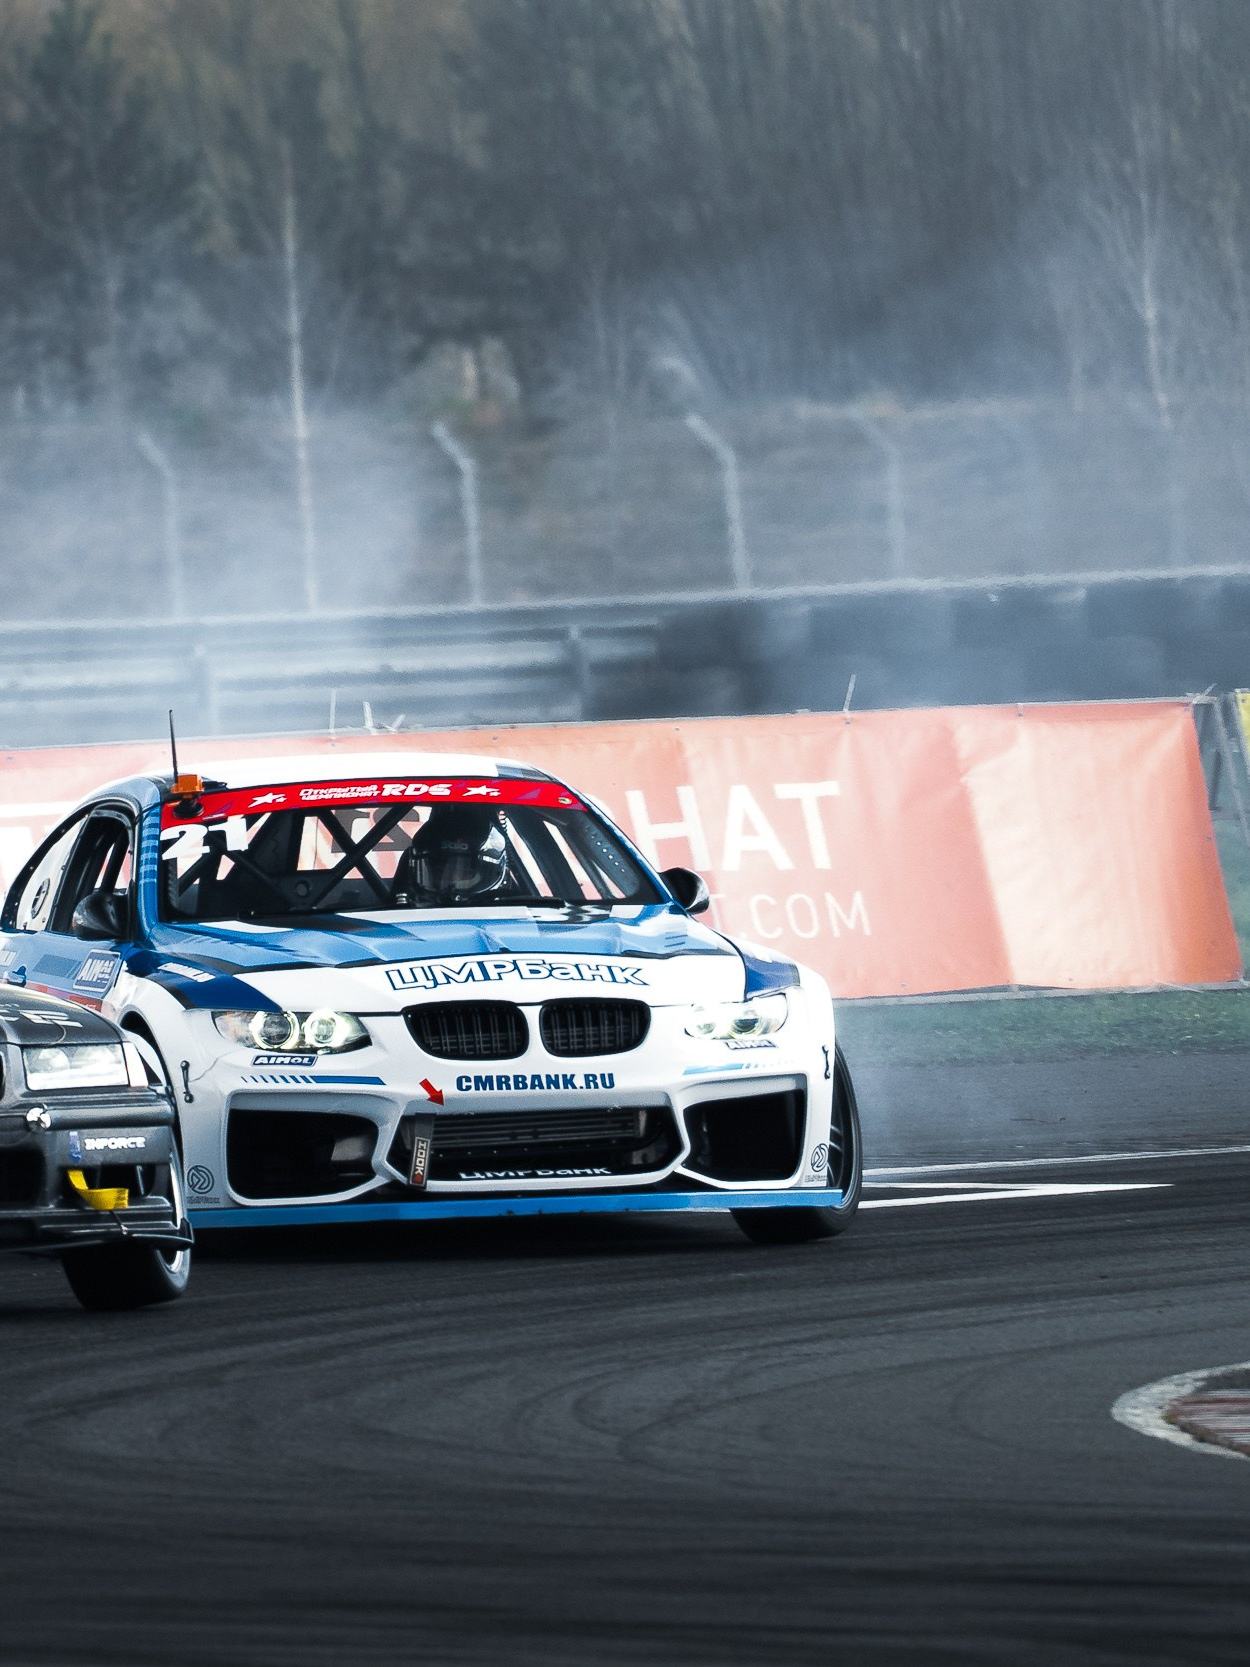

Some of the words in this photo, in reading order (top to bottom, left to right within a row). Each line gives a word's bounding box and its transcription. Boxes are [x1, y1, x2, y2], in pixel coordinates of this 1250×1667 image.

[382, 783, 452, 796] RDS
[587, 780, 841, 872] НАТ
[160, 813, 250, 861] 21
[254, 1056, 312, 1065] AIMOL
[456, 1073, 616, 1092] CMRBANK.RU
[84, 1136, 146, 1151] INFORCE
